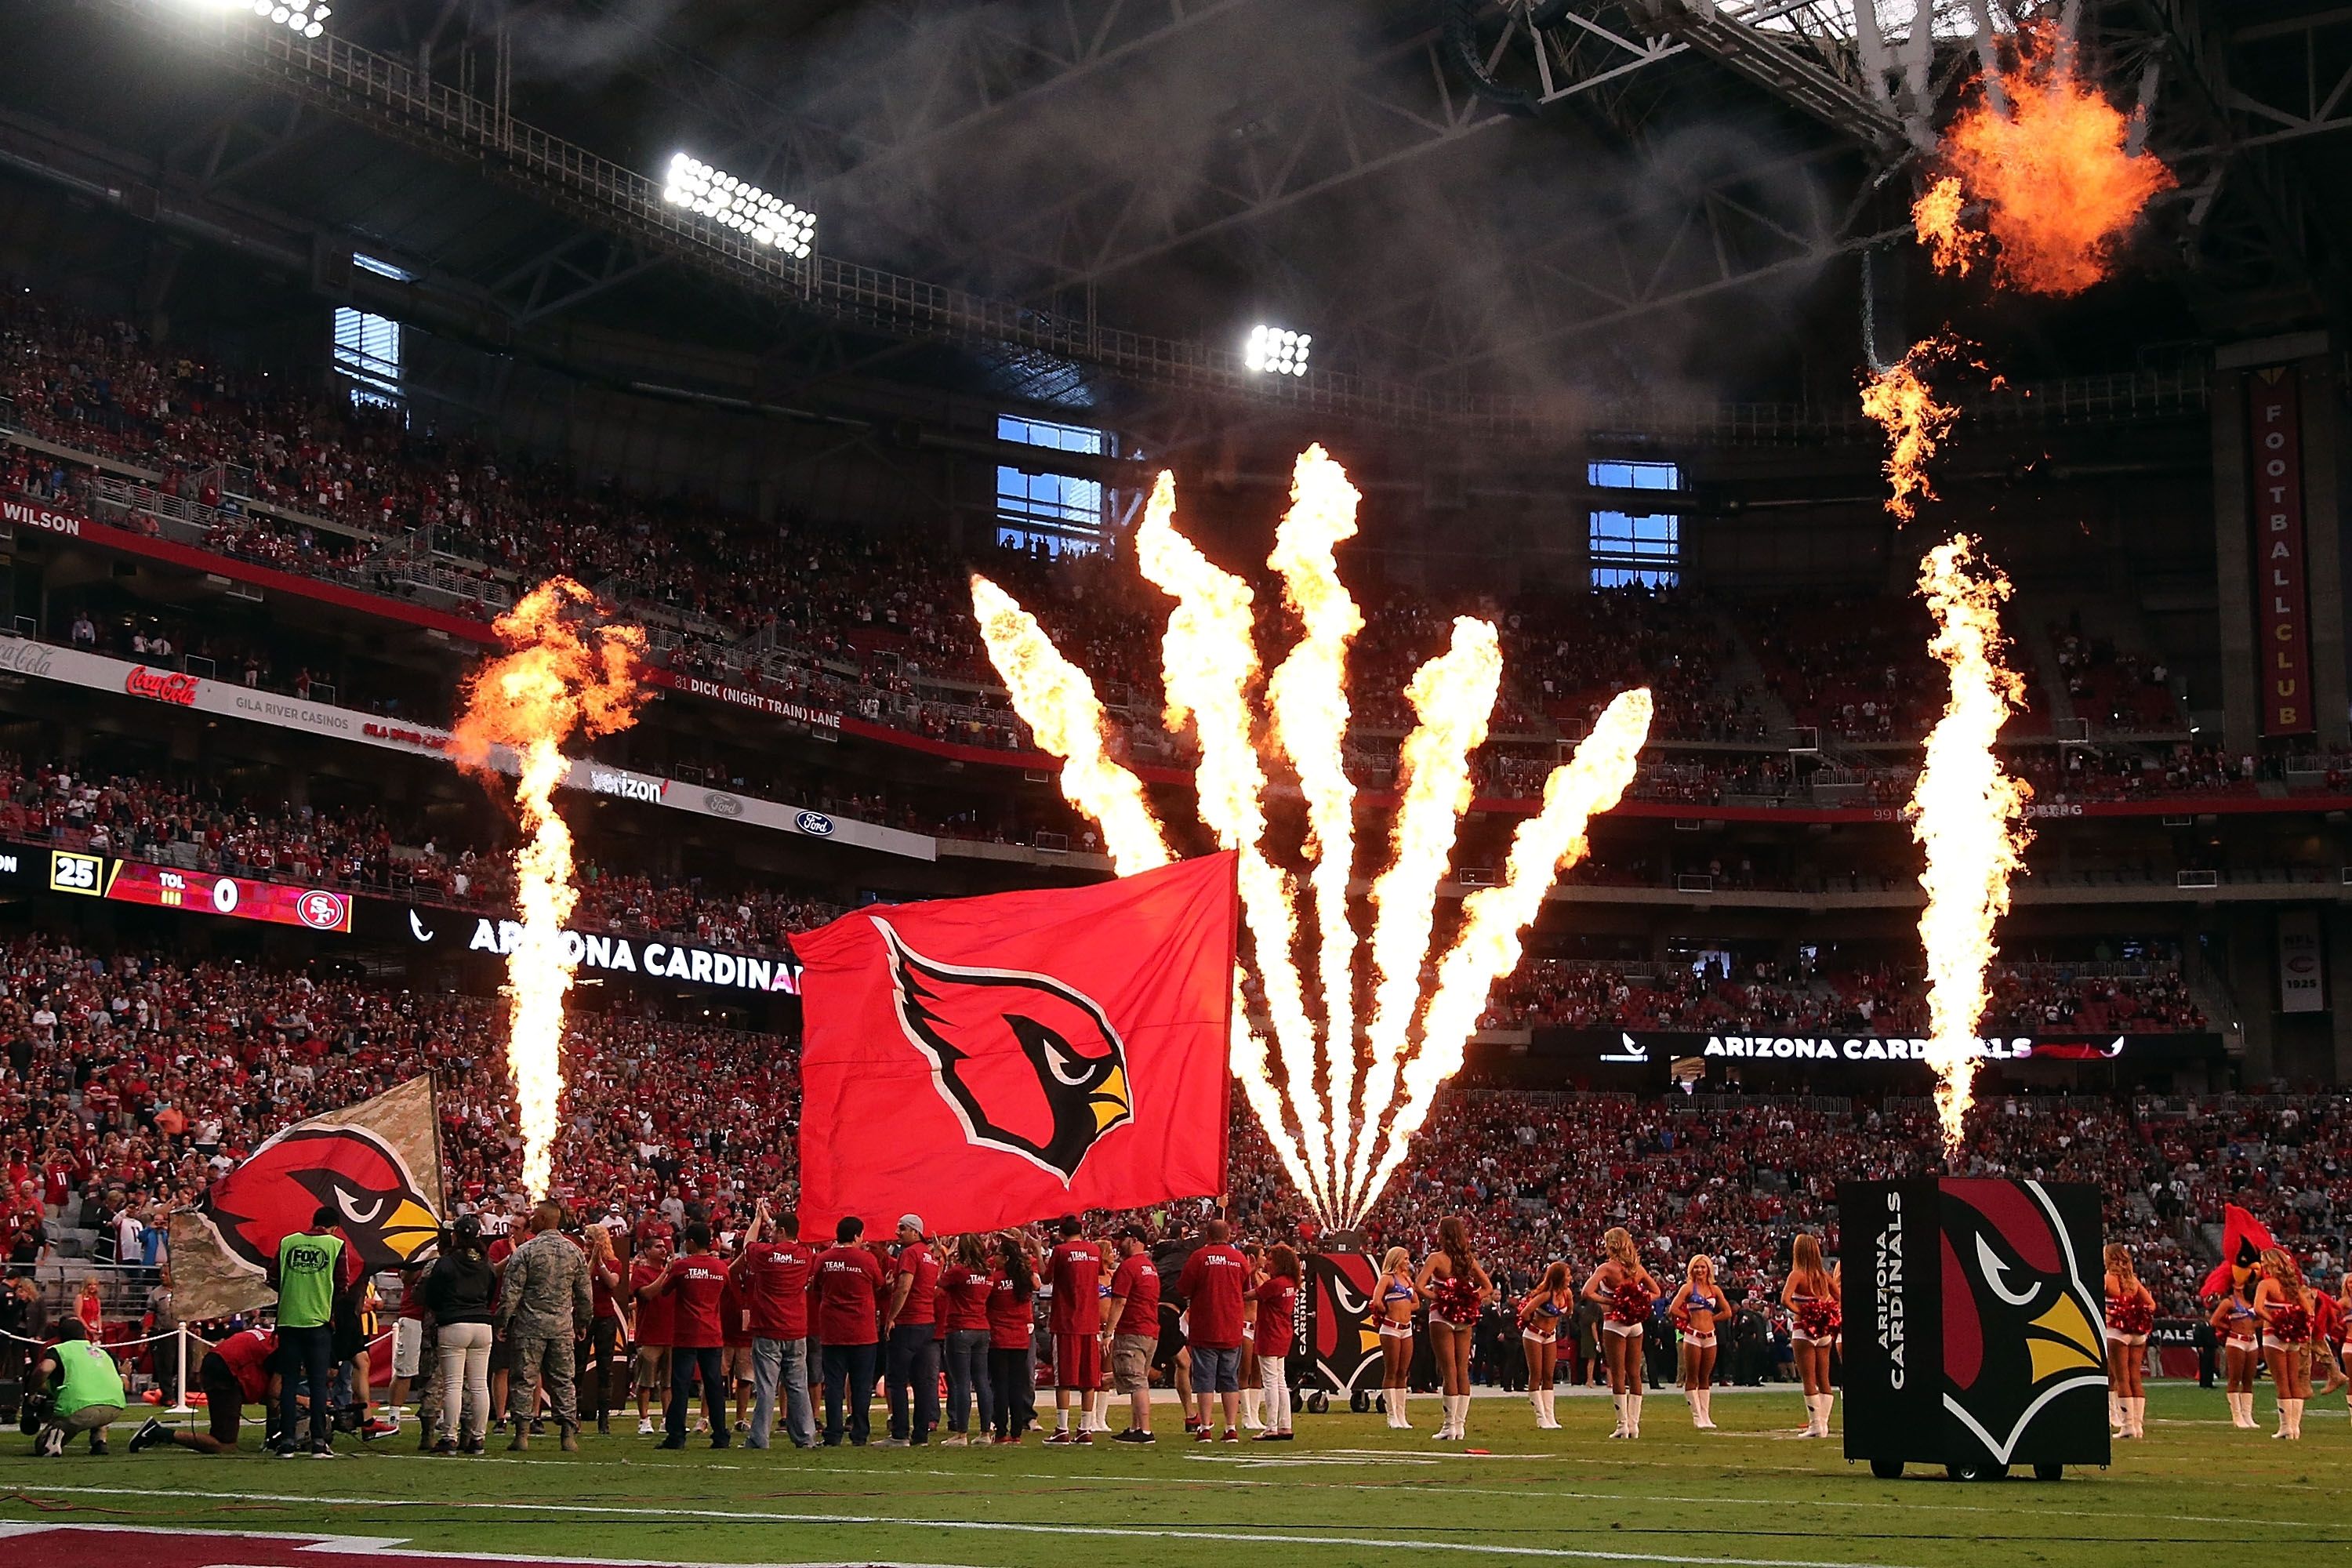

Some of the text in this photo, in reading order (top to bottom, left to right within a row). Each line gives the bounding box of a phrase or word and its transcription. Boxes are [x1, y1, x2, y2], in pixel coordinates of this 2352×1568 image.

[2, 502, 79, 536] WILSON
[2265, 405, 2292, 614] FOOTBALL
[125, 665, 200, 706] Coca-Cola
[2276, 625, 2297, 725] CLUB
[236, 696, 349, 730] GILA RIVER CASINOS
[675, 675, 840, 728] 81 DICK (NIGHT TRAIN) LANE
[710, 794, 738, 814] Ford
[1873, 809, 1892, 821] 99
[803, 816, 829, 833] Ford
[56, 857, 94, 888] 25
[159, 872, 186, 890] TOL
[213, 877, 238, 913] 0
[470, 917, 637, 973] ARONA
[2286, 978, 2317, 989] 1925
[1703, 1036, 2032, 1060] ARIZONA CARDALS
[56, 1172, 67, 1185] 11
[292, 1249, 321, 1263] FOX
[773, 1252, 792, 1261] TEAM
[688, 1268, 709, 1276] TEAM
[970, 1274, 985, 1283] TEAM
[1876, 1191, 1905, 1391] ARIZONA CARDINALS
